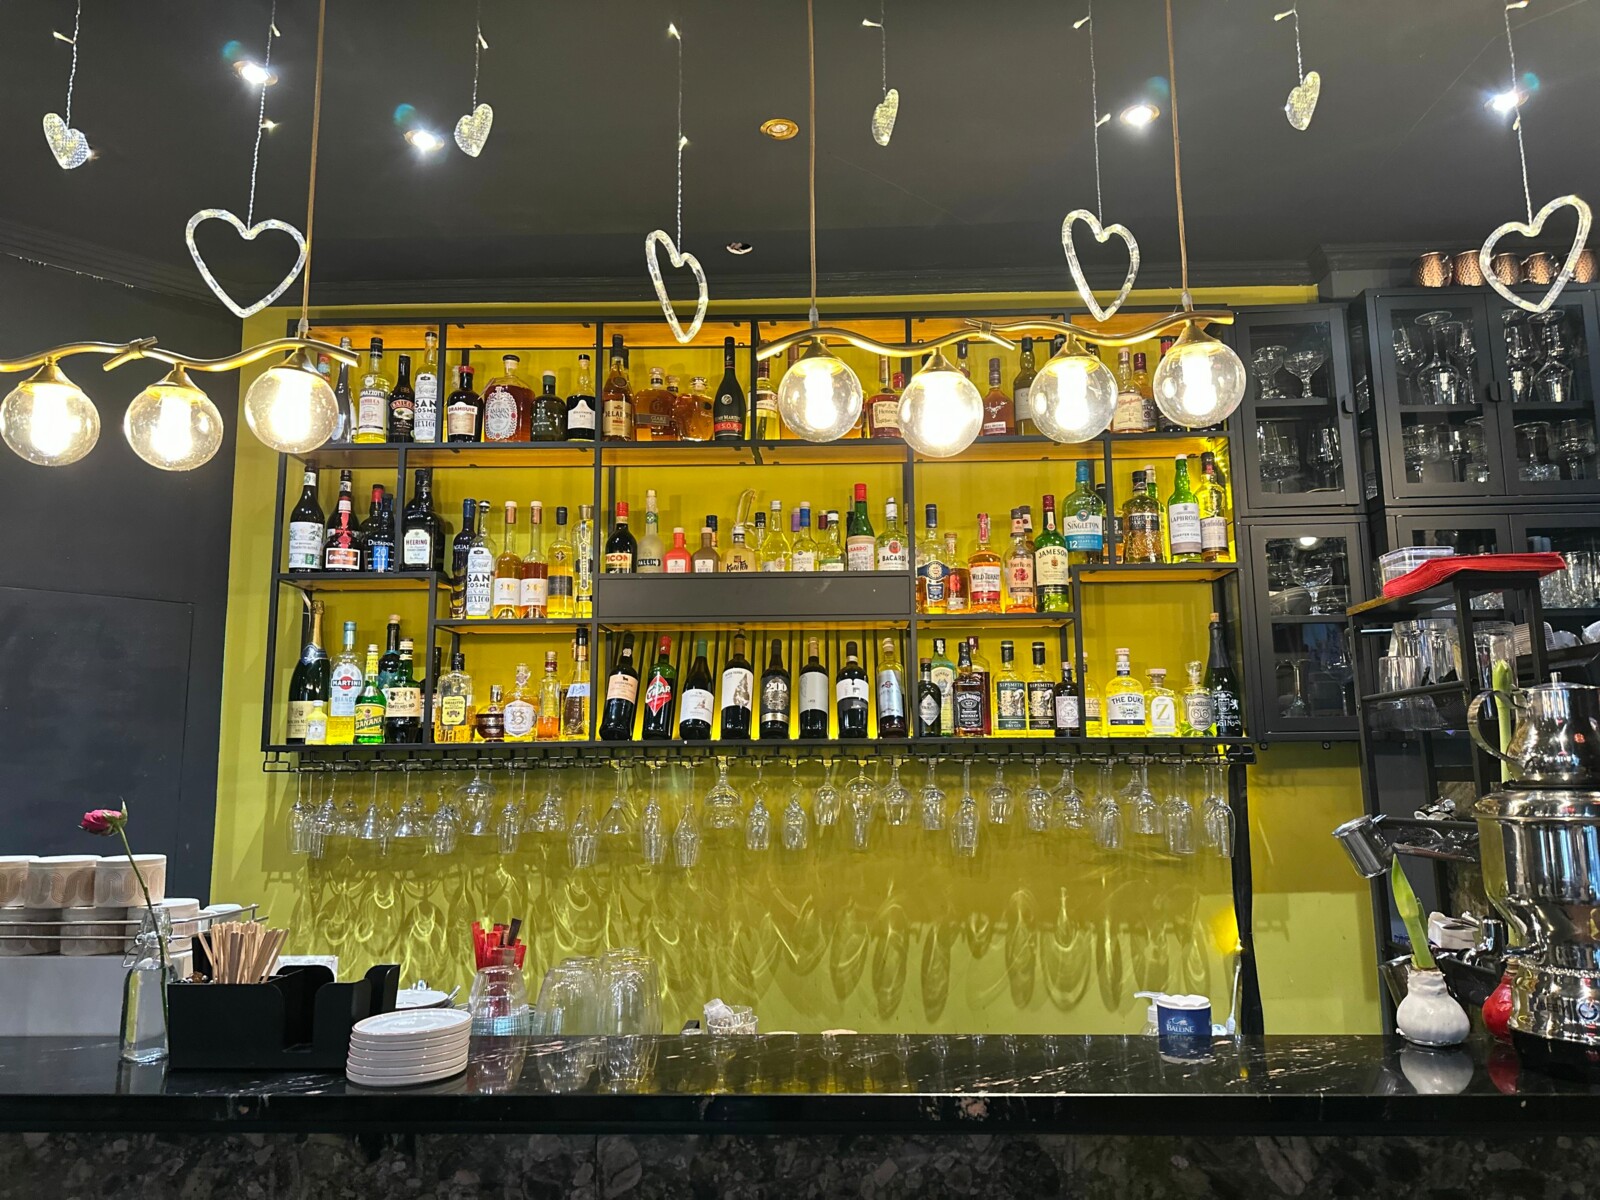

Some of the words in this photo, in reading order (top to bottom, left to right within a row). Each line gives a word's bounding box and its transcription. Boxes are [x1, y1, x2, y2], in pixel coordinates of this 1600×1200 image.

[1067, 521, 1099, 529] SINGLETON
[368, 539, 394, 547] DICTADOR
[1069, 540, 1078, 548] 12
[375, 548, 387, 556] 20
[1038, 548, 1068, 559] JAMESON
[468, 574, 490, 582] SAN
[766, 682, 788, 691] 200
[1111, 696, 1125, 704] THE
[1127, 696, 1143, 704] DUKE
[1155, 703, 1170, 720] Z
[1191, 708, 1210, 718] 66
